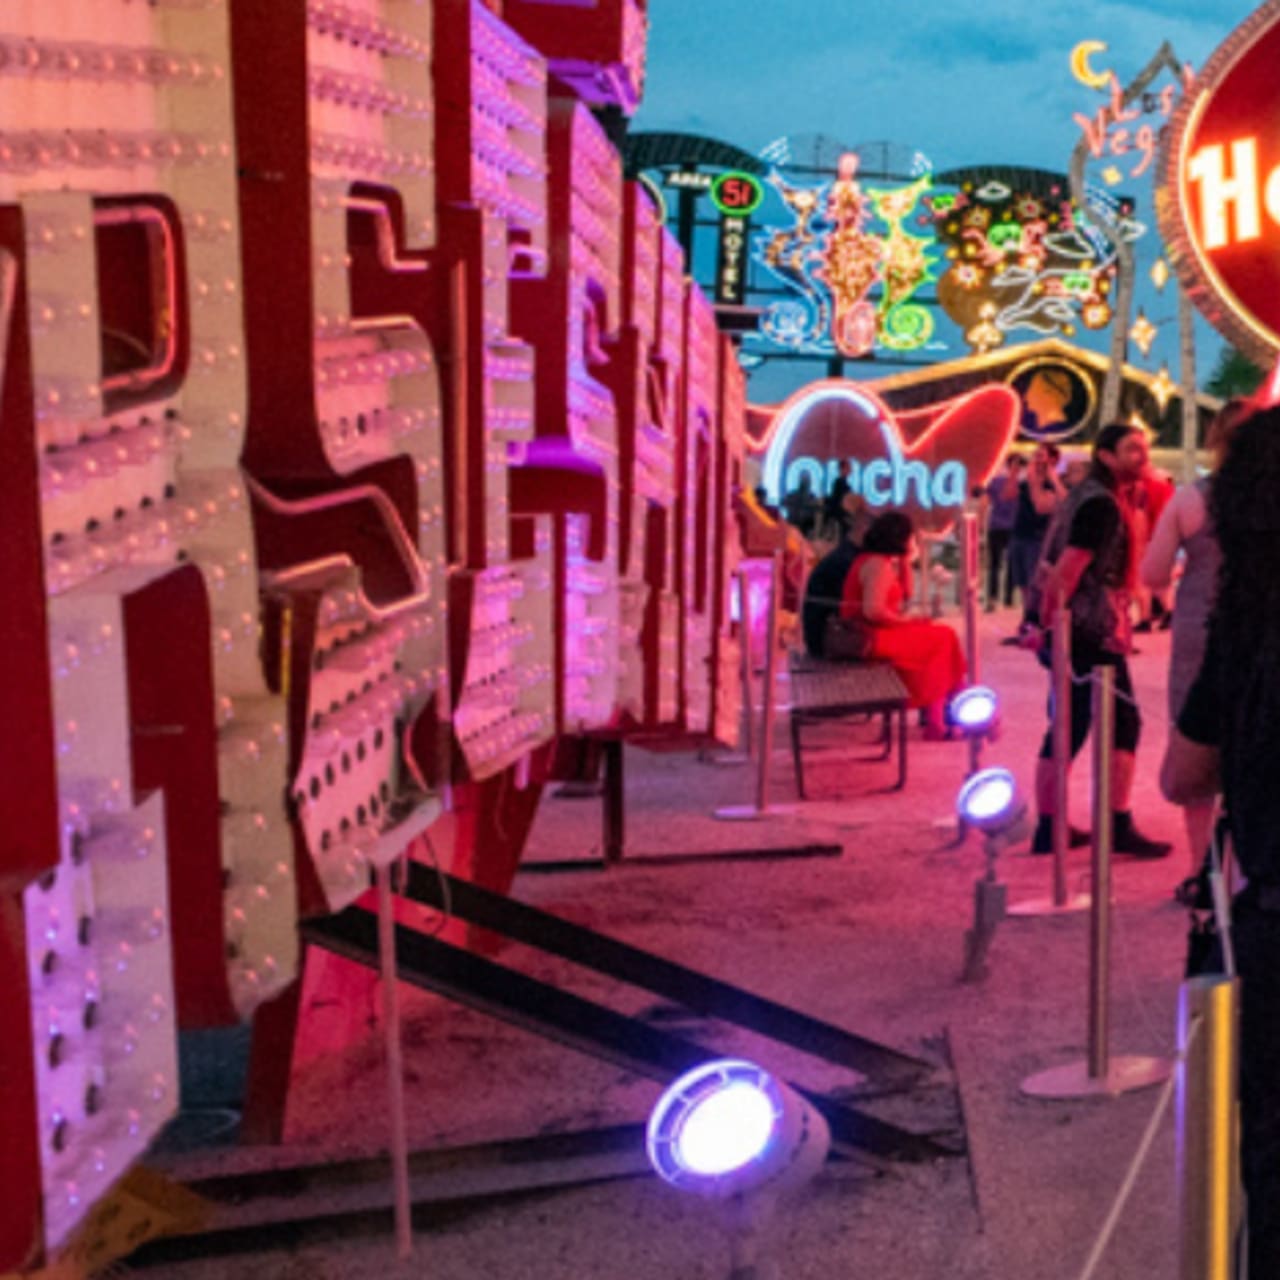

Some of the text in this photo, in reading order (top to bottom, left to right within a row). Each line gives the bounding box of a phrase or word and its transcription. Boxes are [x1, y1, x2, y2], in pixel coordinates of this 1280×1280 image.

[1072, 105, 1157, 177] Veg
[722, 178, 752, 207] 51
[722, 217, 744, 299] MOTEL
